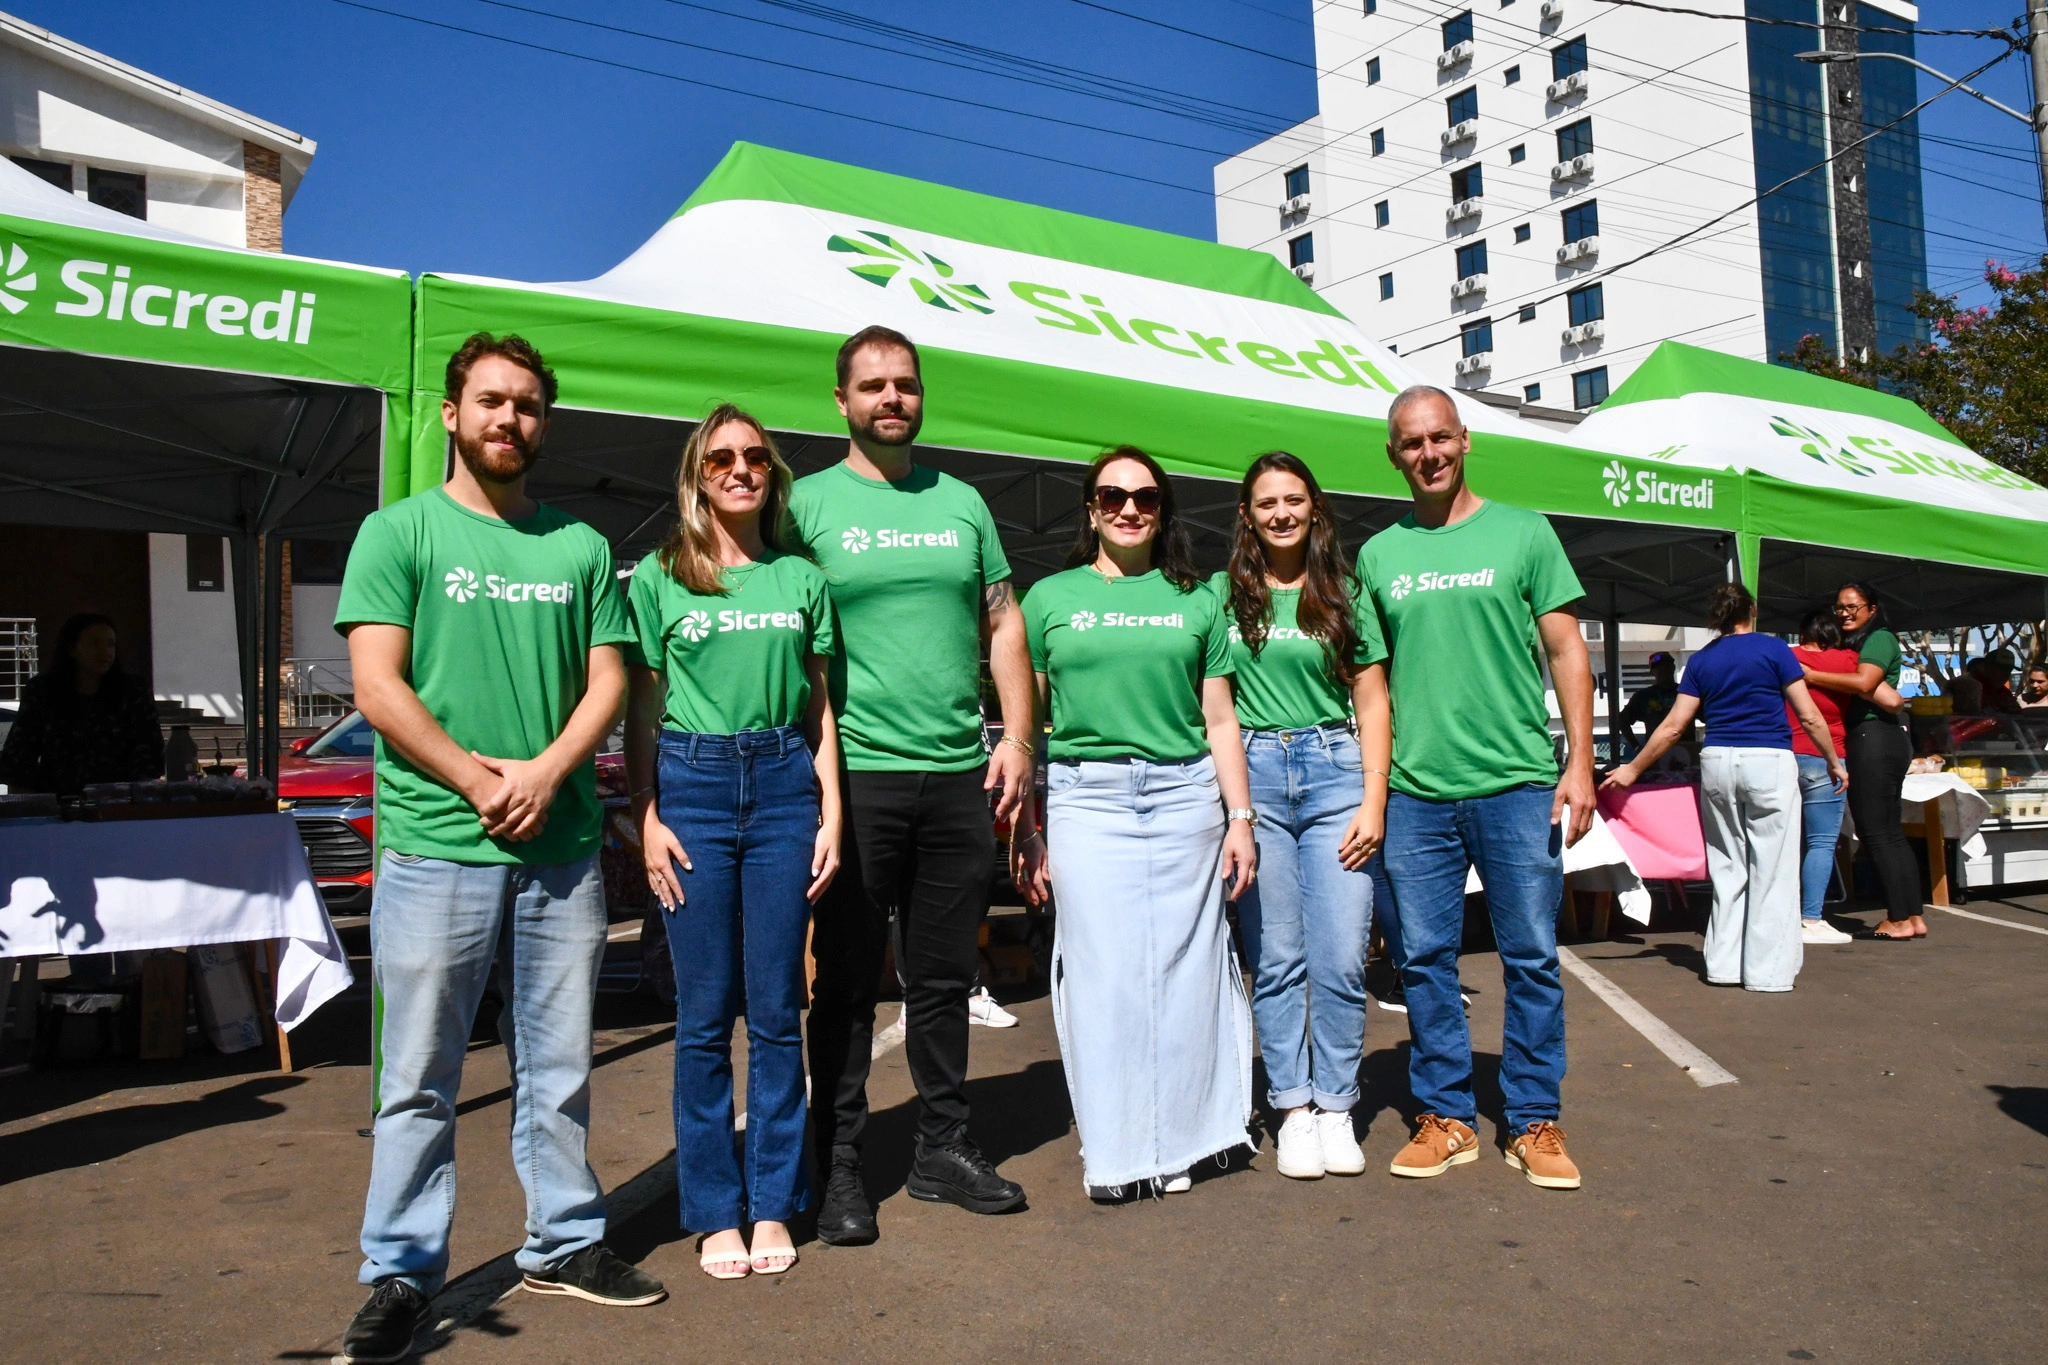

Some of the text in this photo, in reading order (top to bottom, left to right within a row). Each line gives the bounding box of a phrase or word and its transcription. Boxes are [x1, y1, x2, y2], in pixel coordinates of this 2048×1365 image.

[55, 259, 316, 344] Sicredi
[1008, 281, 1400, 394] Sicredi
[1847, 435, 2043, 491] Sicred
[1635, 470, 1713, 510] Sicredi
[876, 529, 959, 548] Sicredi
[485, 574, 574, 606] Sicredi
[1416, 568, 1495, 592] Sicredi
[1101, 612, 1184, 629] Sicredi
